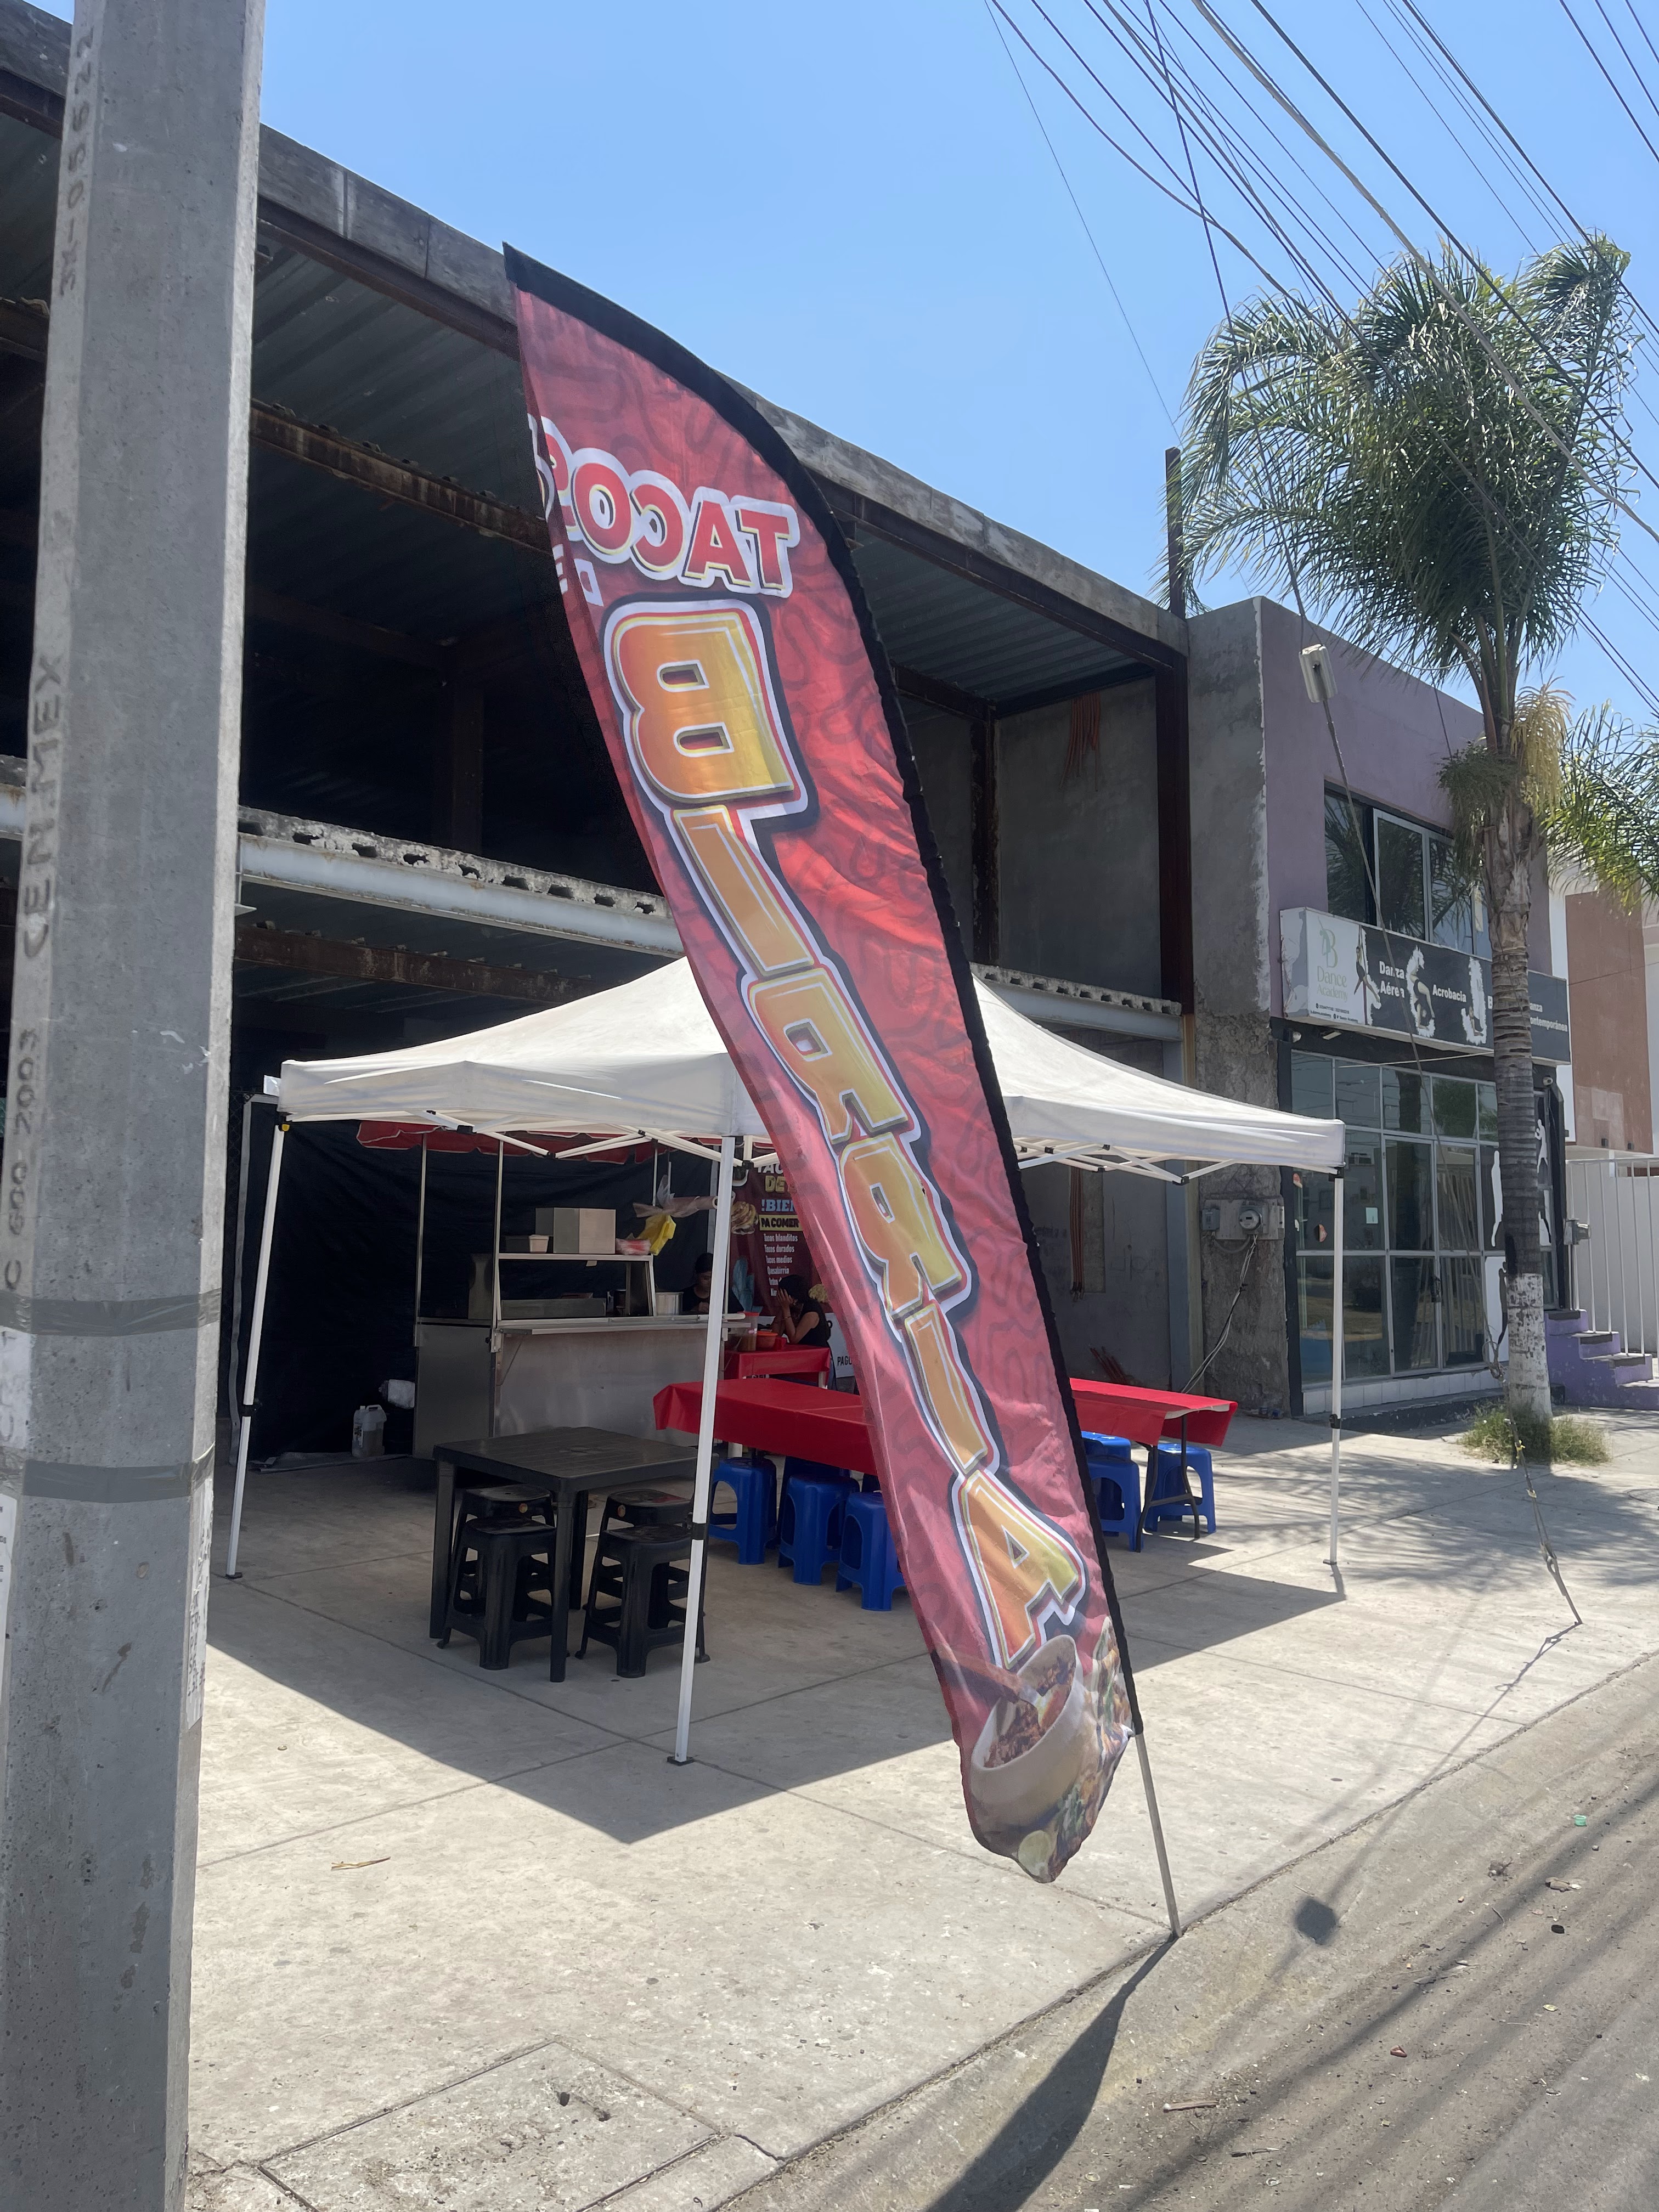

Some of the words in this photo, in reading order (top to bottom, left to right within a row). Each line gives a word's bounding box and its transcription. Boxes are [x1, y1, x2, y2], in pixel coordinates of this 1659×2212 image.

[1317, 966, 1347, 988] Dance
[1379, 961, 1404, 979] Danza
[1317, 984, 1348, 1002] Academy
[1380, 980, 1404, 998] Aérea
[1432, 984, 1466, 1002] Acrobacia
[1530, 1002, 1543, 1012] anza
[1530, 1017, 1568, 1032] ontemporánea
[765, 1175, 785, 1193] DE
